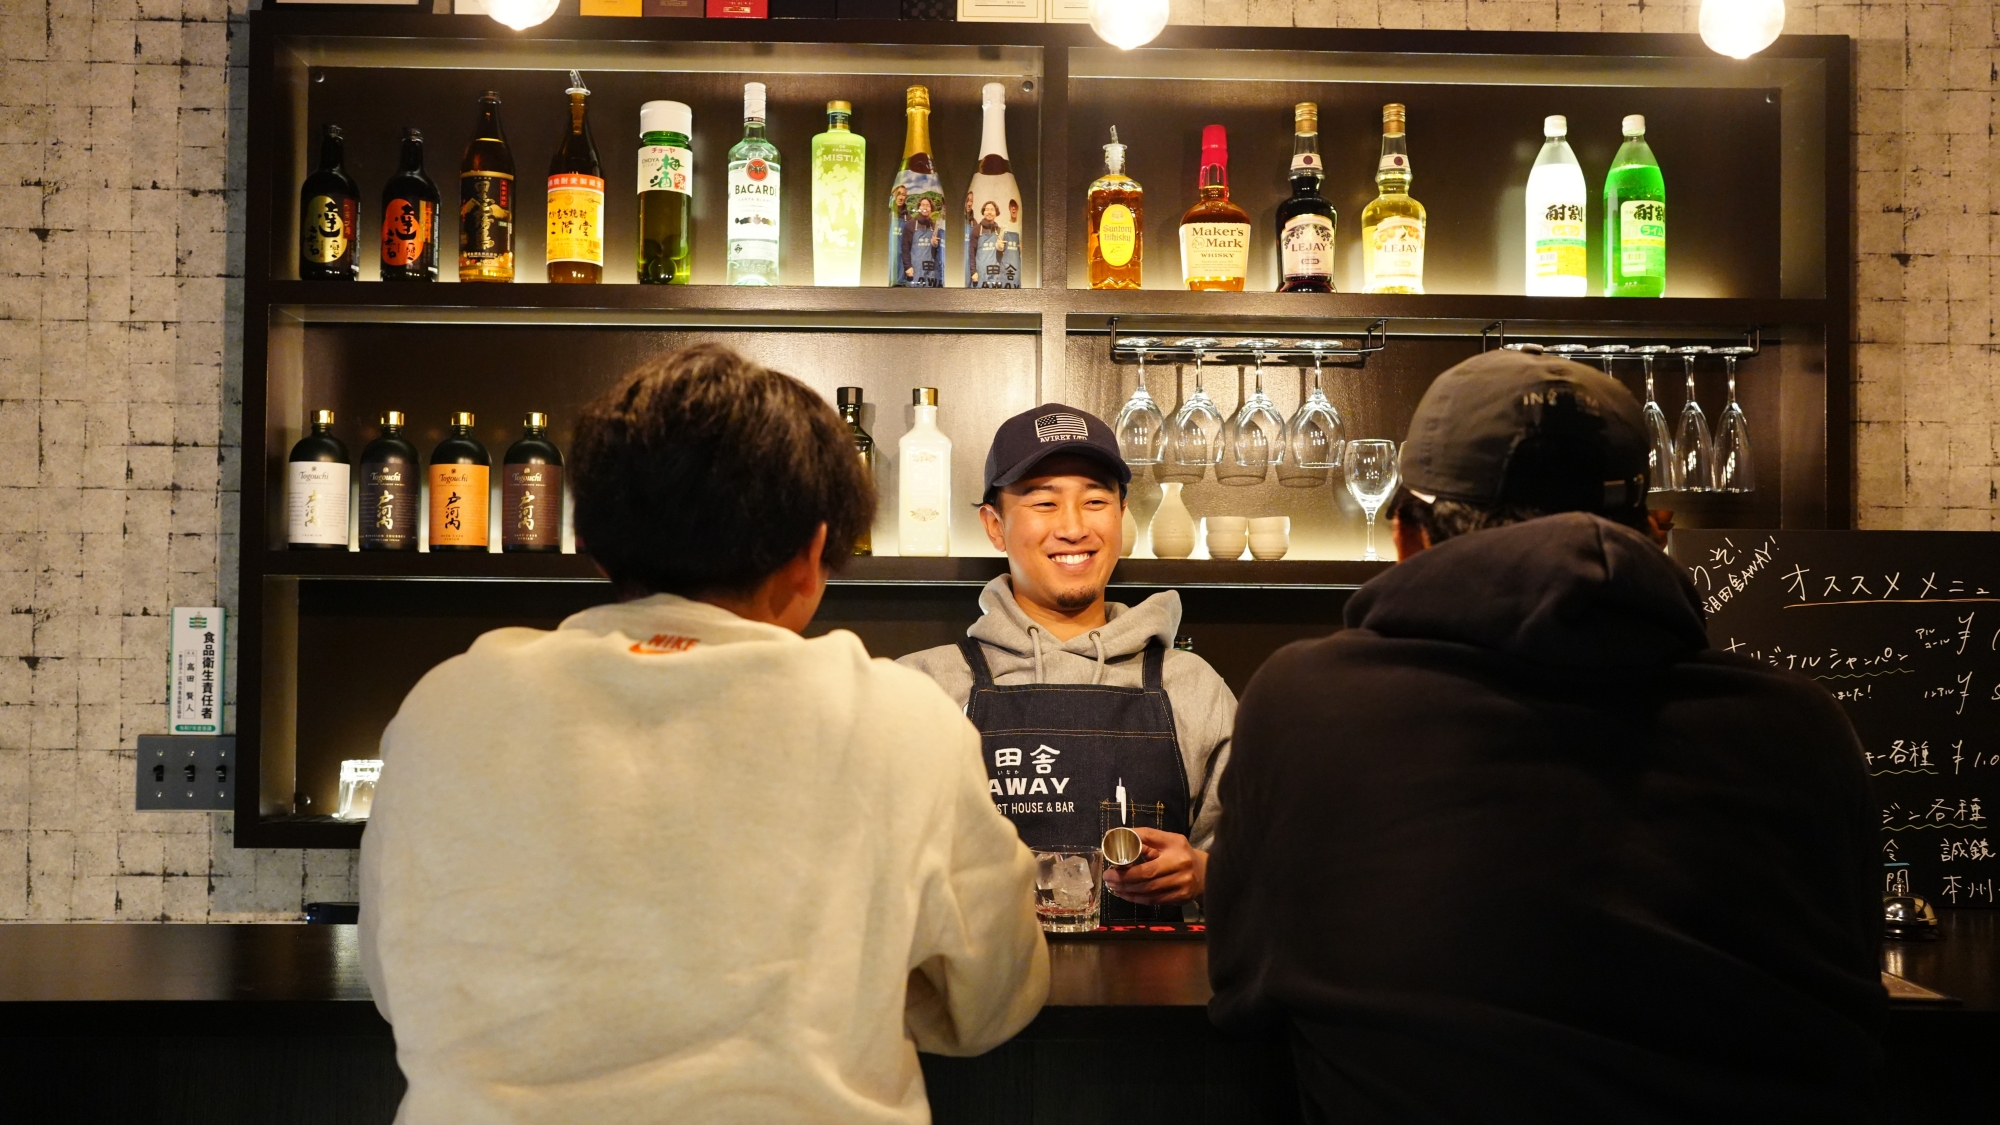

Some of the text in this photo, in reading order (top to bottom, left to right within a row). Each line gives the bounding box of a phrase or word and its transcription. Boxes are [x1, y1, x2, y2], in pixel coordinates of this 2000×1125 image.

[823, 154, 860, 163] MISTIA
[1545, 204, 1583, 223] 酎割
[1103, 225, 1132, 235] Suntory
[1191, 227, 1244, 237] Maker's
[1104, 234, 1131, 243] Whisky
[1206, 238, 1243, 249] Mark
[1292, 243, 1327, 252] LEJAY
[1384, 245, 1419, 253] LEJAY
[986, 263, 1017, 281] 田舎
[1040, 434, 1071, 443] AVIREX
[299, 471, 330, 482] Togouchi
[370, 471, 401, 483] Togouchi
[439, 473, 468, 484] Togouchi
[512, 473, 542, 483] Togouchi
[201, 631, 216, 720] 食品衛生責任者
[994, 744, 1061, 774] 田舎
[989, 777, 1070, 796] AWAY
[1011, 802, 1044, 814] HOUSE
[1046, 802, 1053, 813] &
[1055, 801, 1075, 813] BAR
